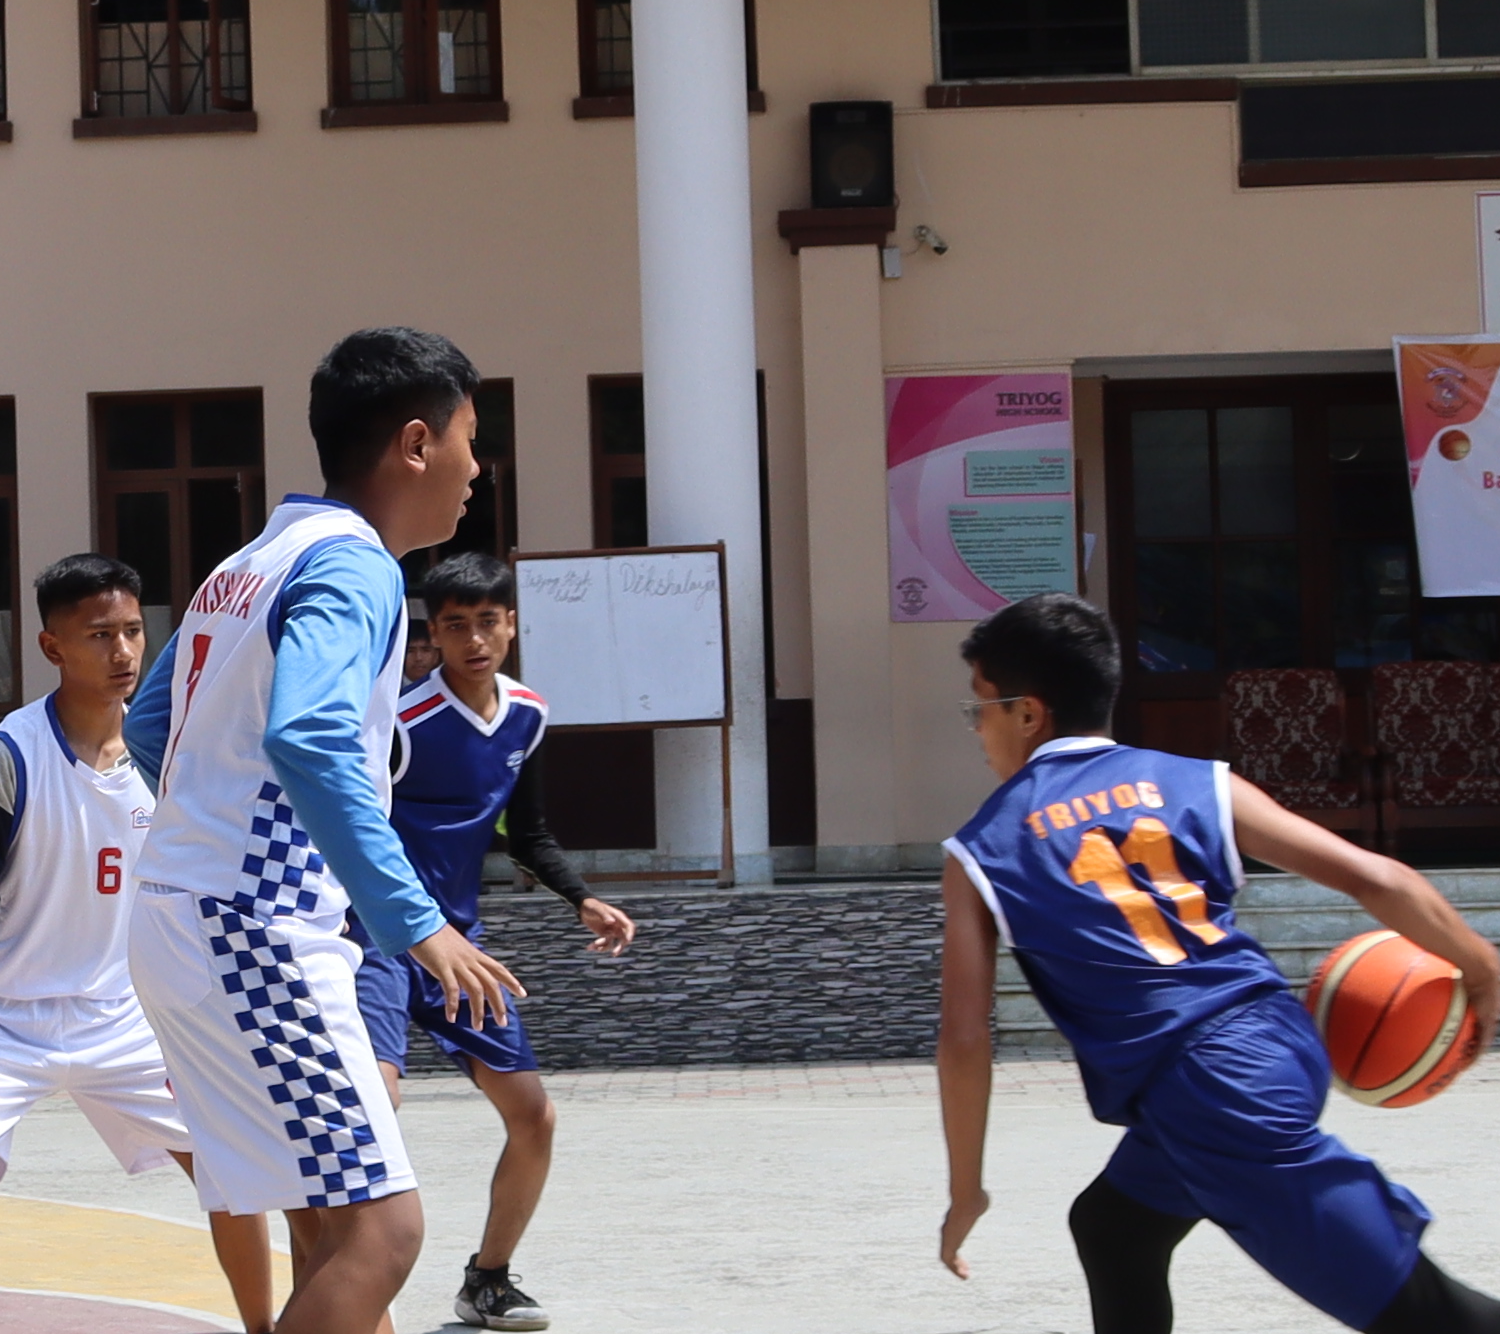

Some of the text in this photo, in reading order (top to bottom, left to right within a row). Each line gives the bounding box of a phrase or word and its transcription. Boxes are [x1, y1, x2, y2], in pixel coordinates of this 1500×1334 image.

[995, 391, 1062, 406] TRIYOG
[1025, 780, 1165, 840] TRIYOG
[96, 847, 122, 894] 6
[1066, 816, 1229, 966] 11
